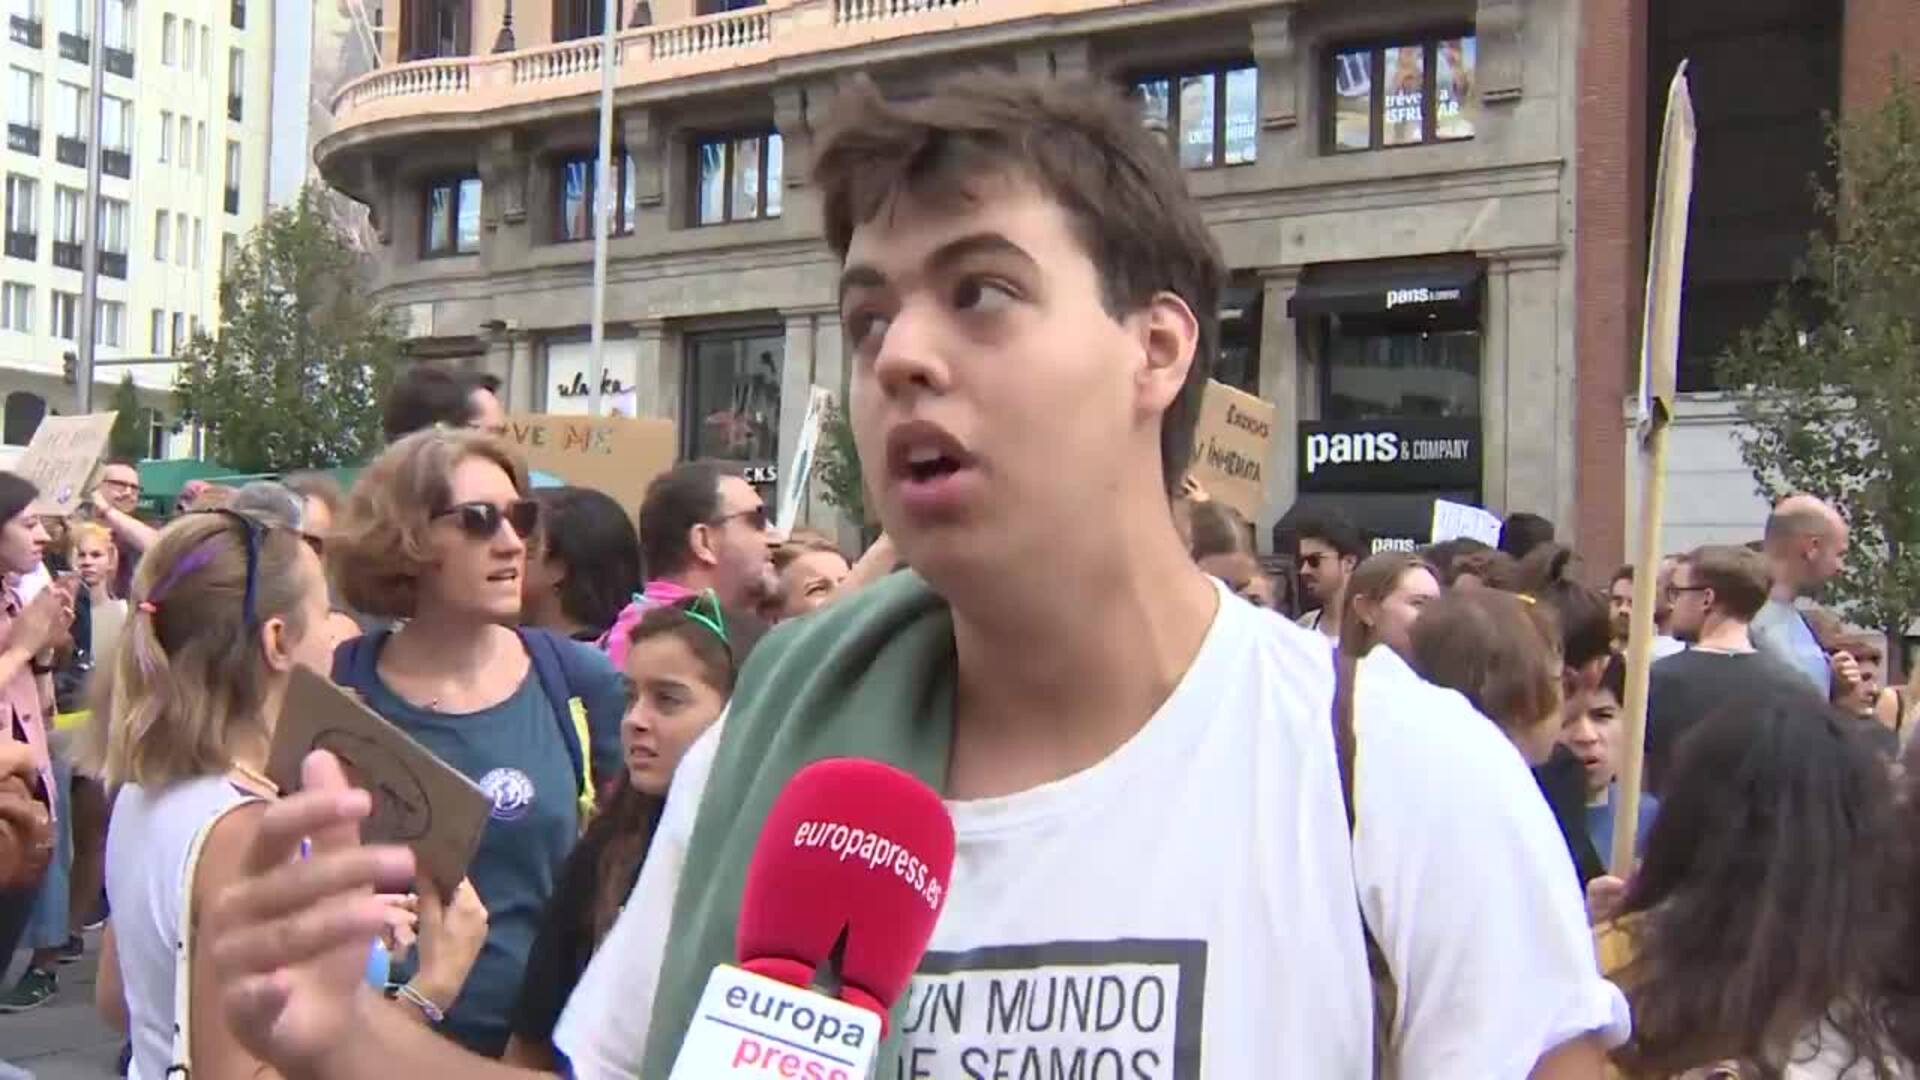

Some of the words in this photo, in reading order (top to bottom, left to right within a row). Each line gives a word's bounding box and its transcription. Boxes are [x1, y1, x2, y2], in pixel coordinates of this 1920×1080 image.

[1386, 288, 1429, 309] pans
[557, 368, 636, 397] ulaka
[1307, 432, 1399, 473] pans
[1401, 441, 1410, 461] &
[1413, 439, 1470, 461] COMPANY
[744, 465, 778, 482] CKS
[1372, 537, 1415, 554] pans
[794, 820, 942, 910] europapress.es
[725, 985, 865, 1049] europa
[986, 975, 1165, 1035] MUNDO
